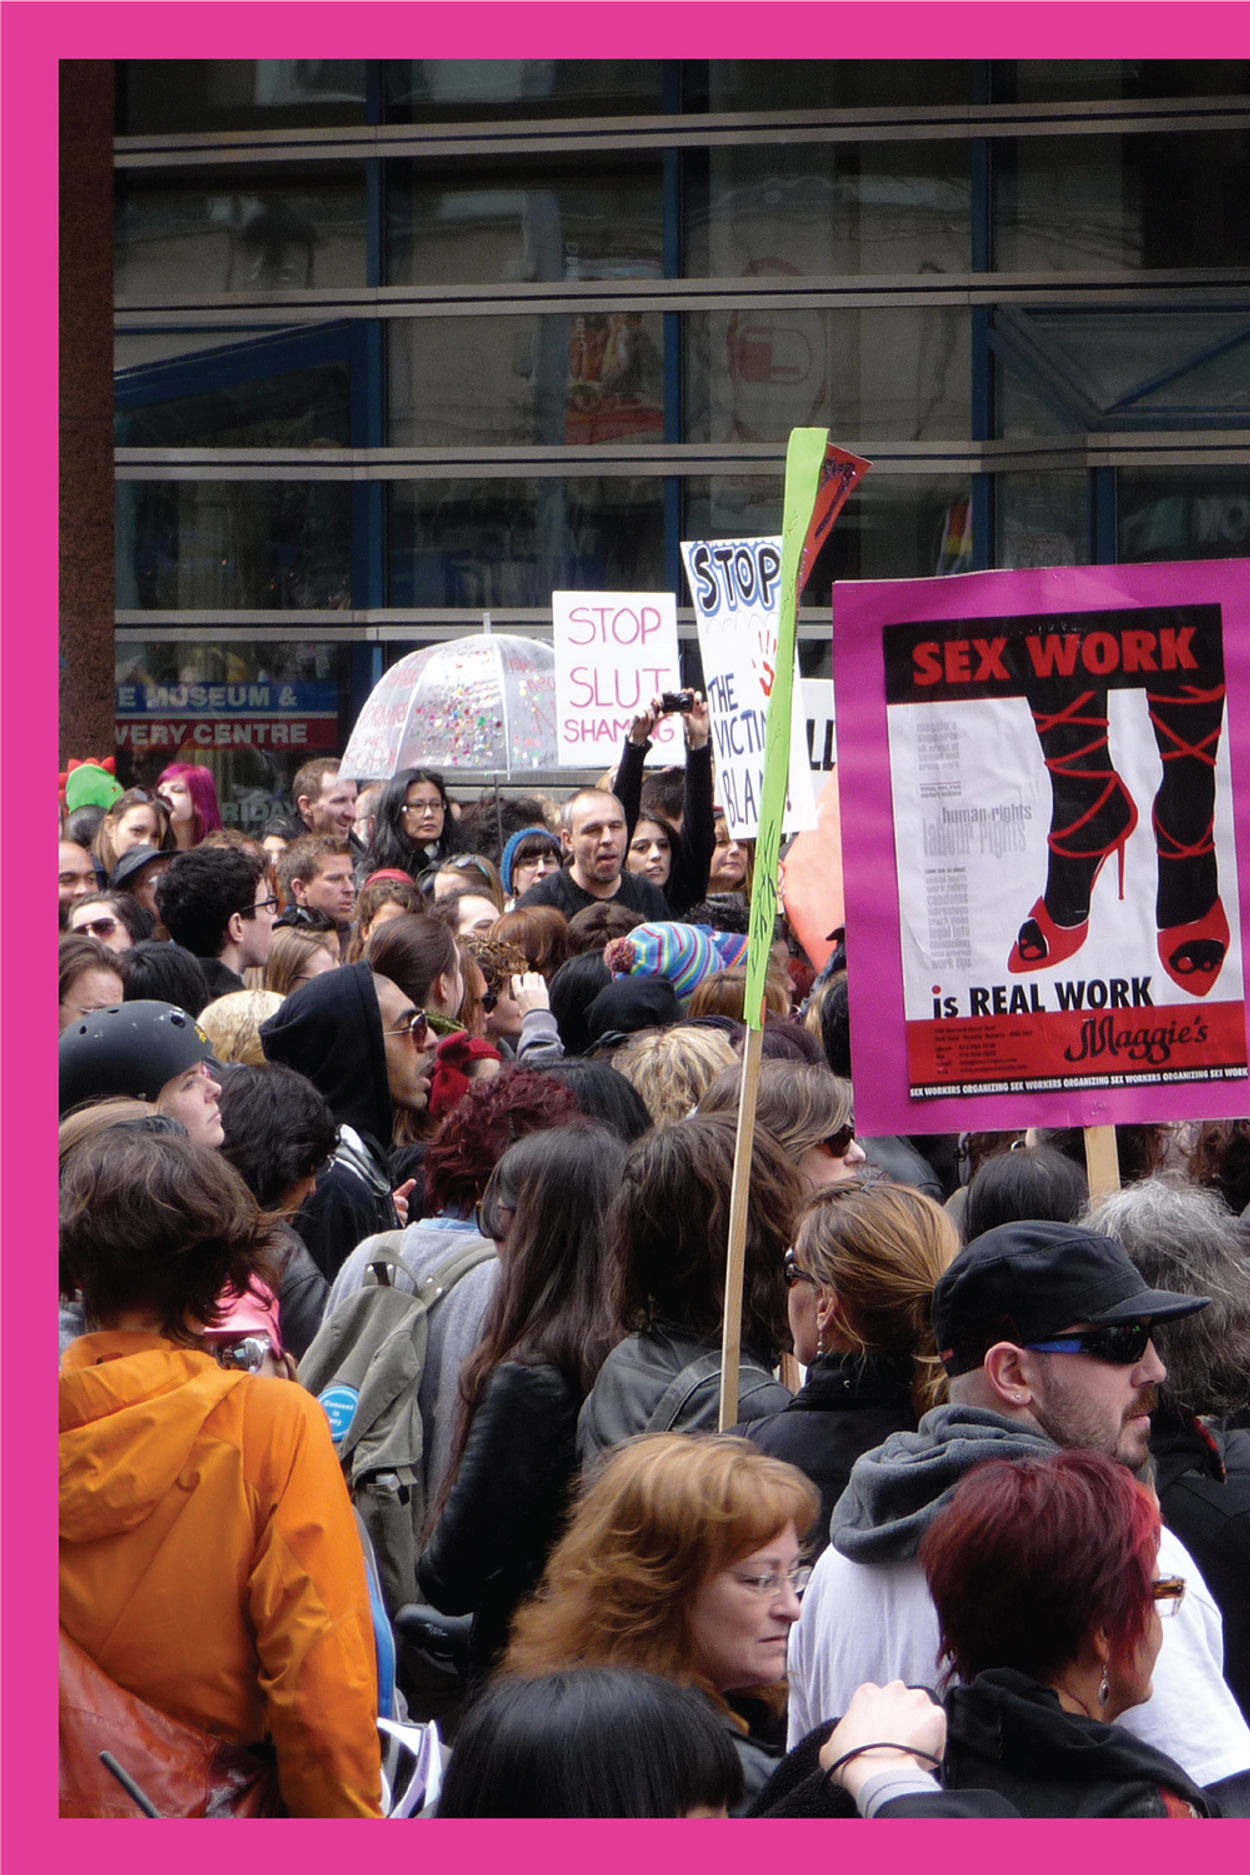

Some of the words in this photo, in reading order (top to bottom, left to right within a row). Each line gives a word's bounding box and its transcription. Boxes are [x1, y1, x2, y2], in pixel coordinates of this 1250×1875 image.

[692, 545, 781, 612] STOP
[568, 607, 661, 645] STOP
[912, 637, 1010, 685] SEX
[1025, 627, 1199, 677] WORK
[146, 686, 270, 707] MUSEUM
[279, 687, 297, 707] &
[569, 666, 671, 709] SLUT
[708, 672, 738, 713] THE
[115, 723, 187, 745] VERY
[194, 723, 307, 745] CENTRE
[714, 709, 766, 759] VICTI
[221, 802, 297, 822] RIDAY
[942, 807, 987, 824] human
[992, 803, 1032, 823] rights
[932, 985, 958, 1019] is
[969, 981, 1046, 1016] REAL
[1054, 976, 1154, 1010] WORK
[1064, 1015, 1208, 1064] Maggie's
[909, 1087, 923, 1097] SEX
[924, 1084, 961, 1097] WORKERS
[962, 1083, 1009, 1094] ORGANIZING
[1010, 1082, 1024, 1092] SEX
[1025, 1079, 1062, 1091] WORKERS
[1063, 1077, 1110, 1088] ORGANIZING
[1110, 1075, 1124, 1086] SEX
[1125, 1073, 1161, 1084] WORKERS
[1163, 1070, 1209, 1081] ORGANIZING
[1210, 1068, 1224, 1079] SEX
